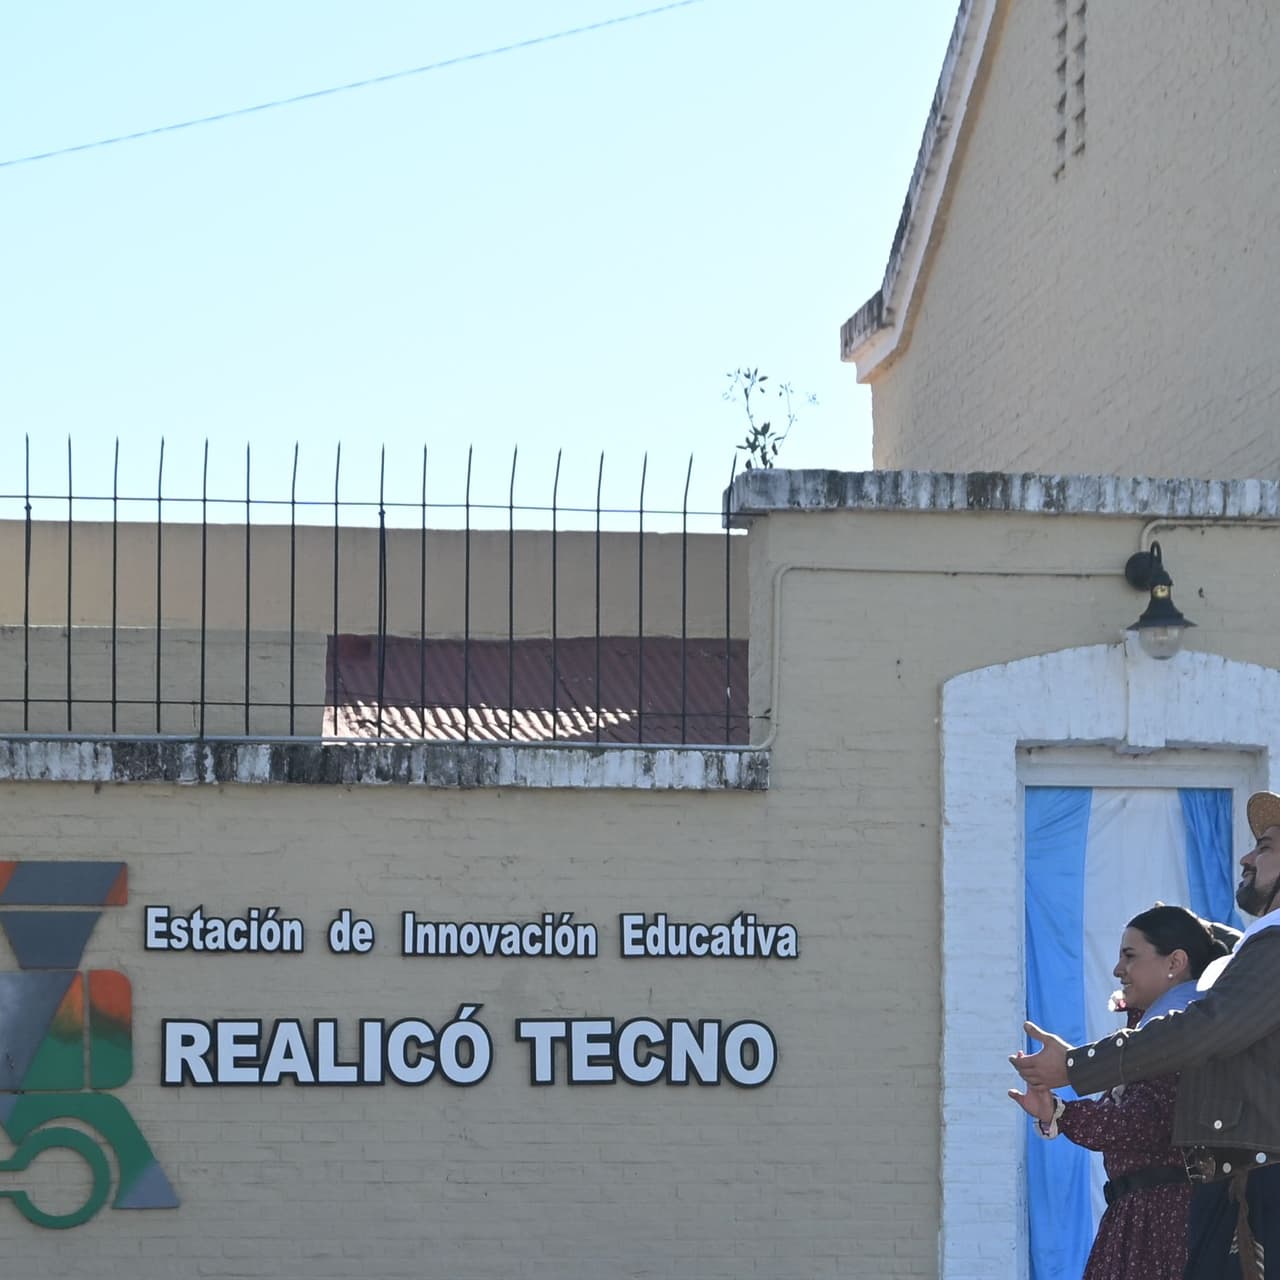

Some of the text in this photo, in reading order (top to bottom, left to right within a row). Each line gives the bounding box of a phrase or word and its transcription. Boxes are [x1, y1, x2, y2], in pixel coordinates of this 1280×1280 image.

[145, 905, 799, 958] Estación de Innovación Educativa
[161, 1004, 777, 1088] REALICÓ TECNO
